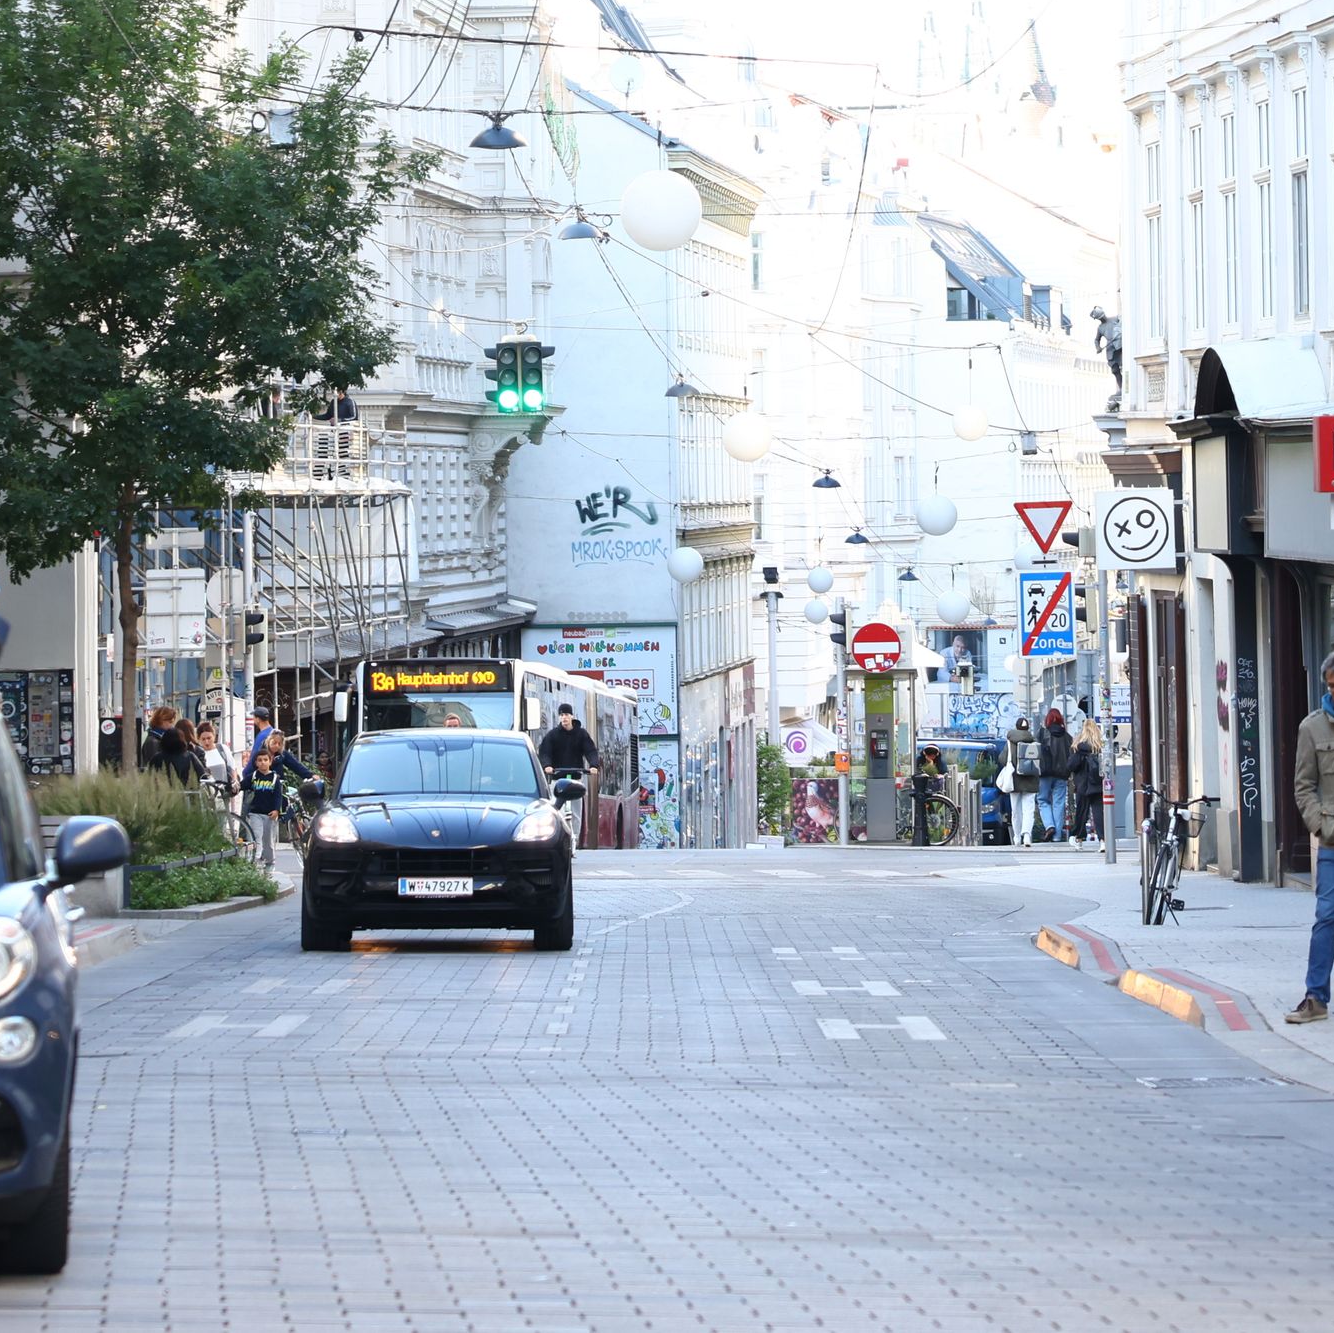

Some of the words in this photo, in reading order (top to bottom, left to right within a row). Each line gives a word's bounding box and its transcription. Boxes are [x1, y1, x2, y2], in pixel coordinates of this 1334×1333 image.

[1051, 613, 1067, 628] 20
[1031, 636, 1065, 649] Zone
[371, 672, 395, 691] 13A
[397, 672, 469, 688] Hauptbahnhof
